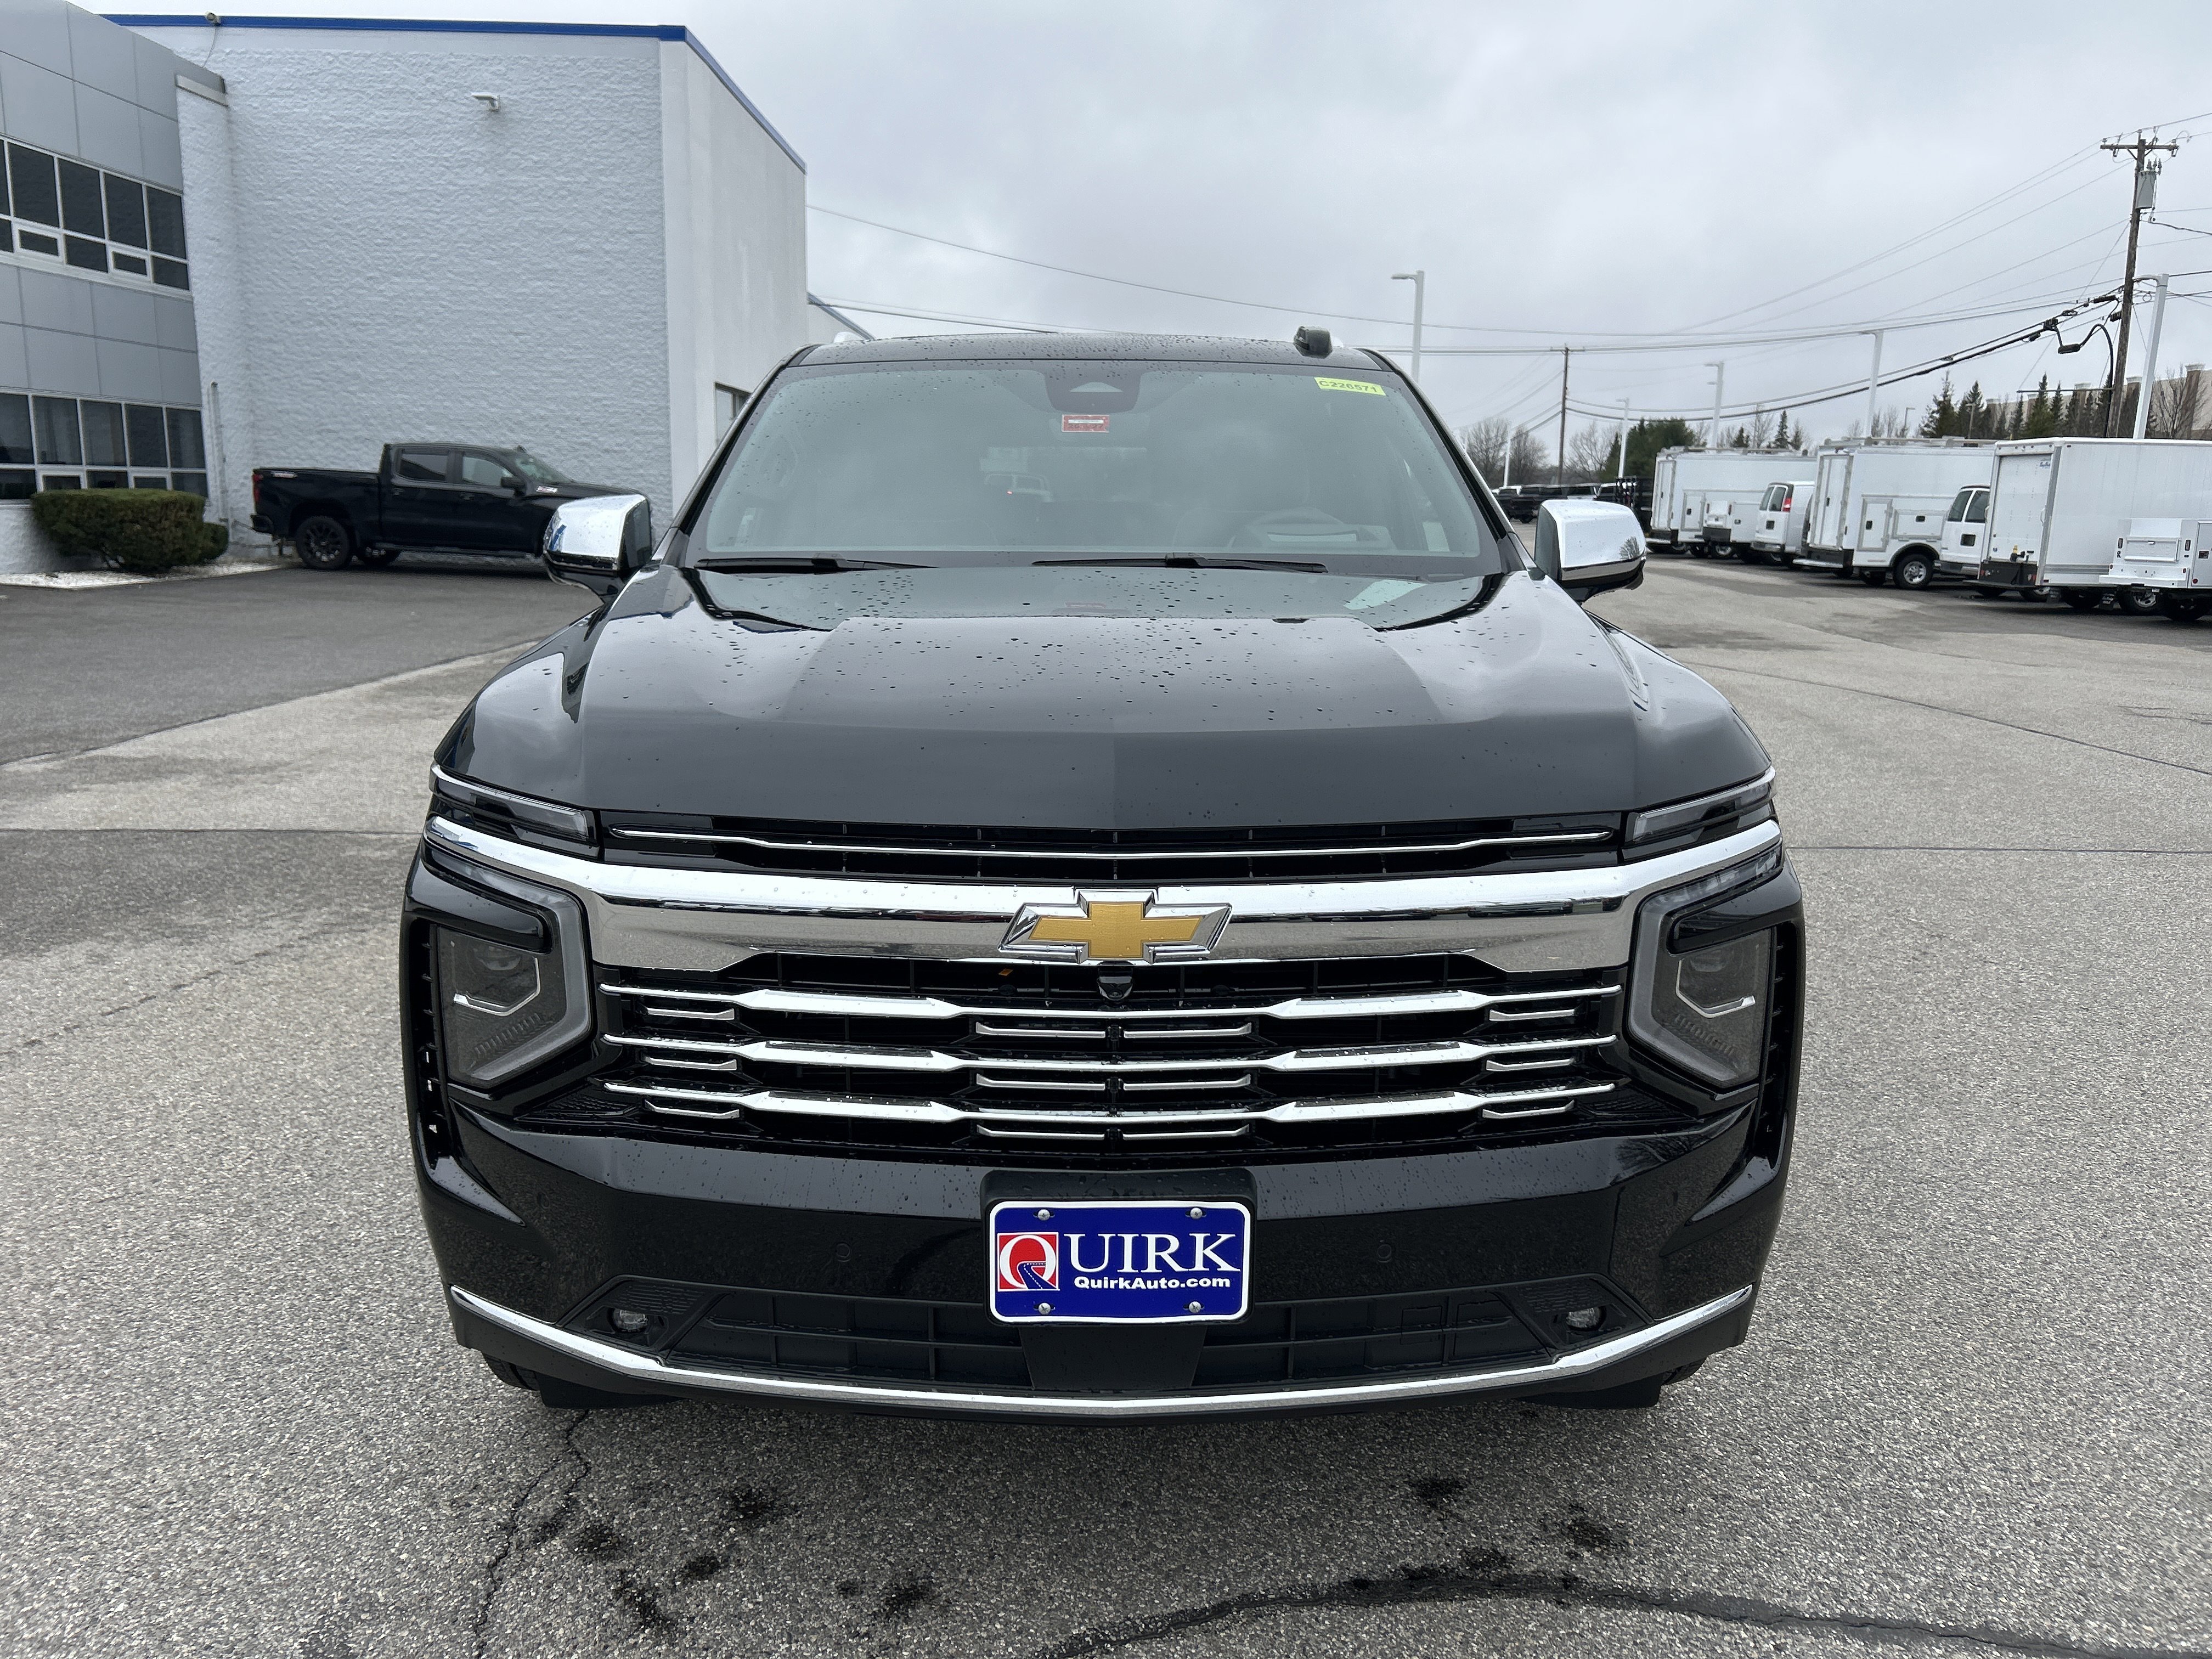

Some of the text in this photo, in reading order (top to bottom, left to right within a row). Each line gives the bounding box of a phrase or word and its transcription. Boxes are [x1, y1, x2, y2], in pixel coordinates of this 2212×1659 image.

[1318, 380, 1378, 393] C226571
[999, 1233, 1241, 1289] QUIRK
[1074, 1276, 1231, 1290] QuirkAuto.com
